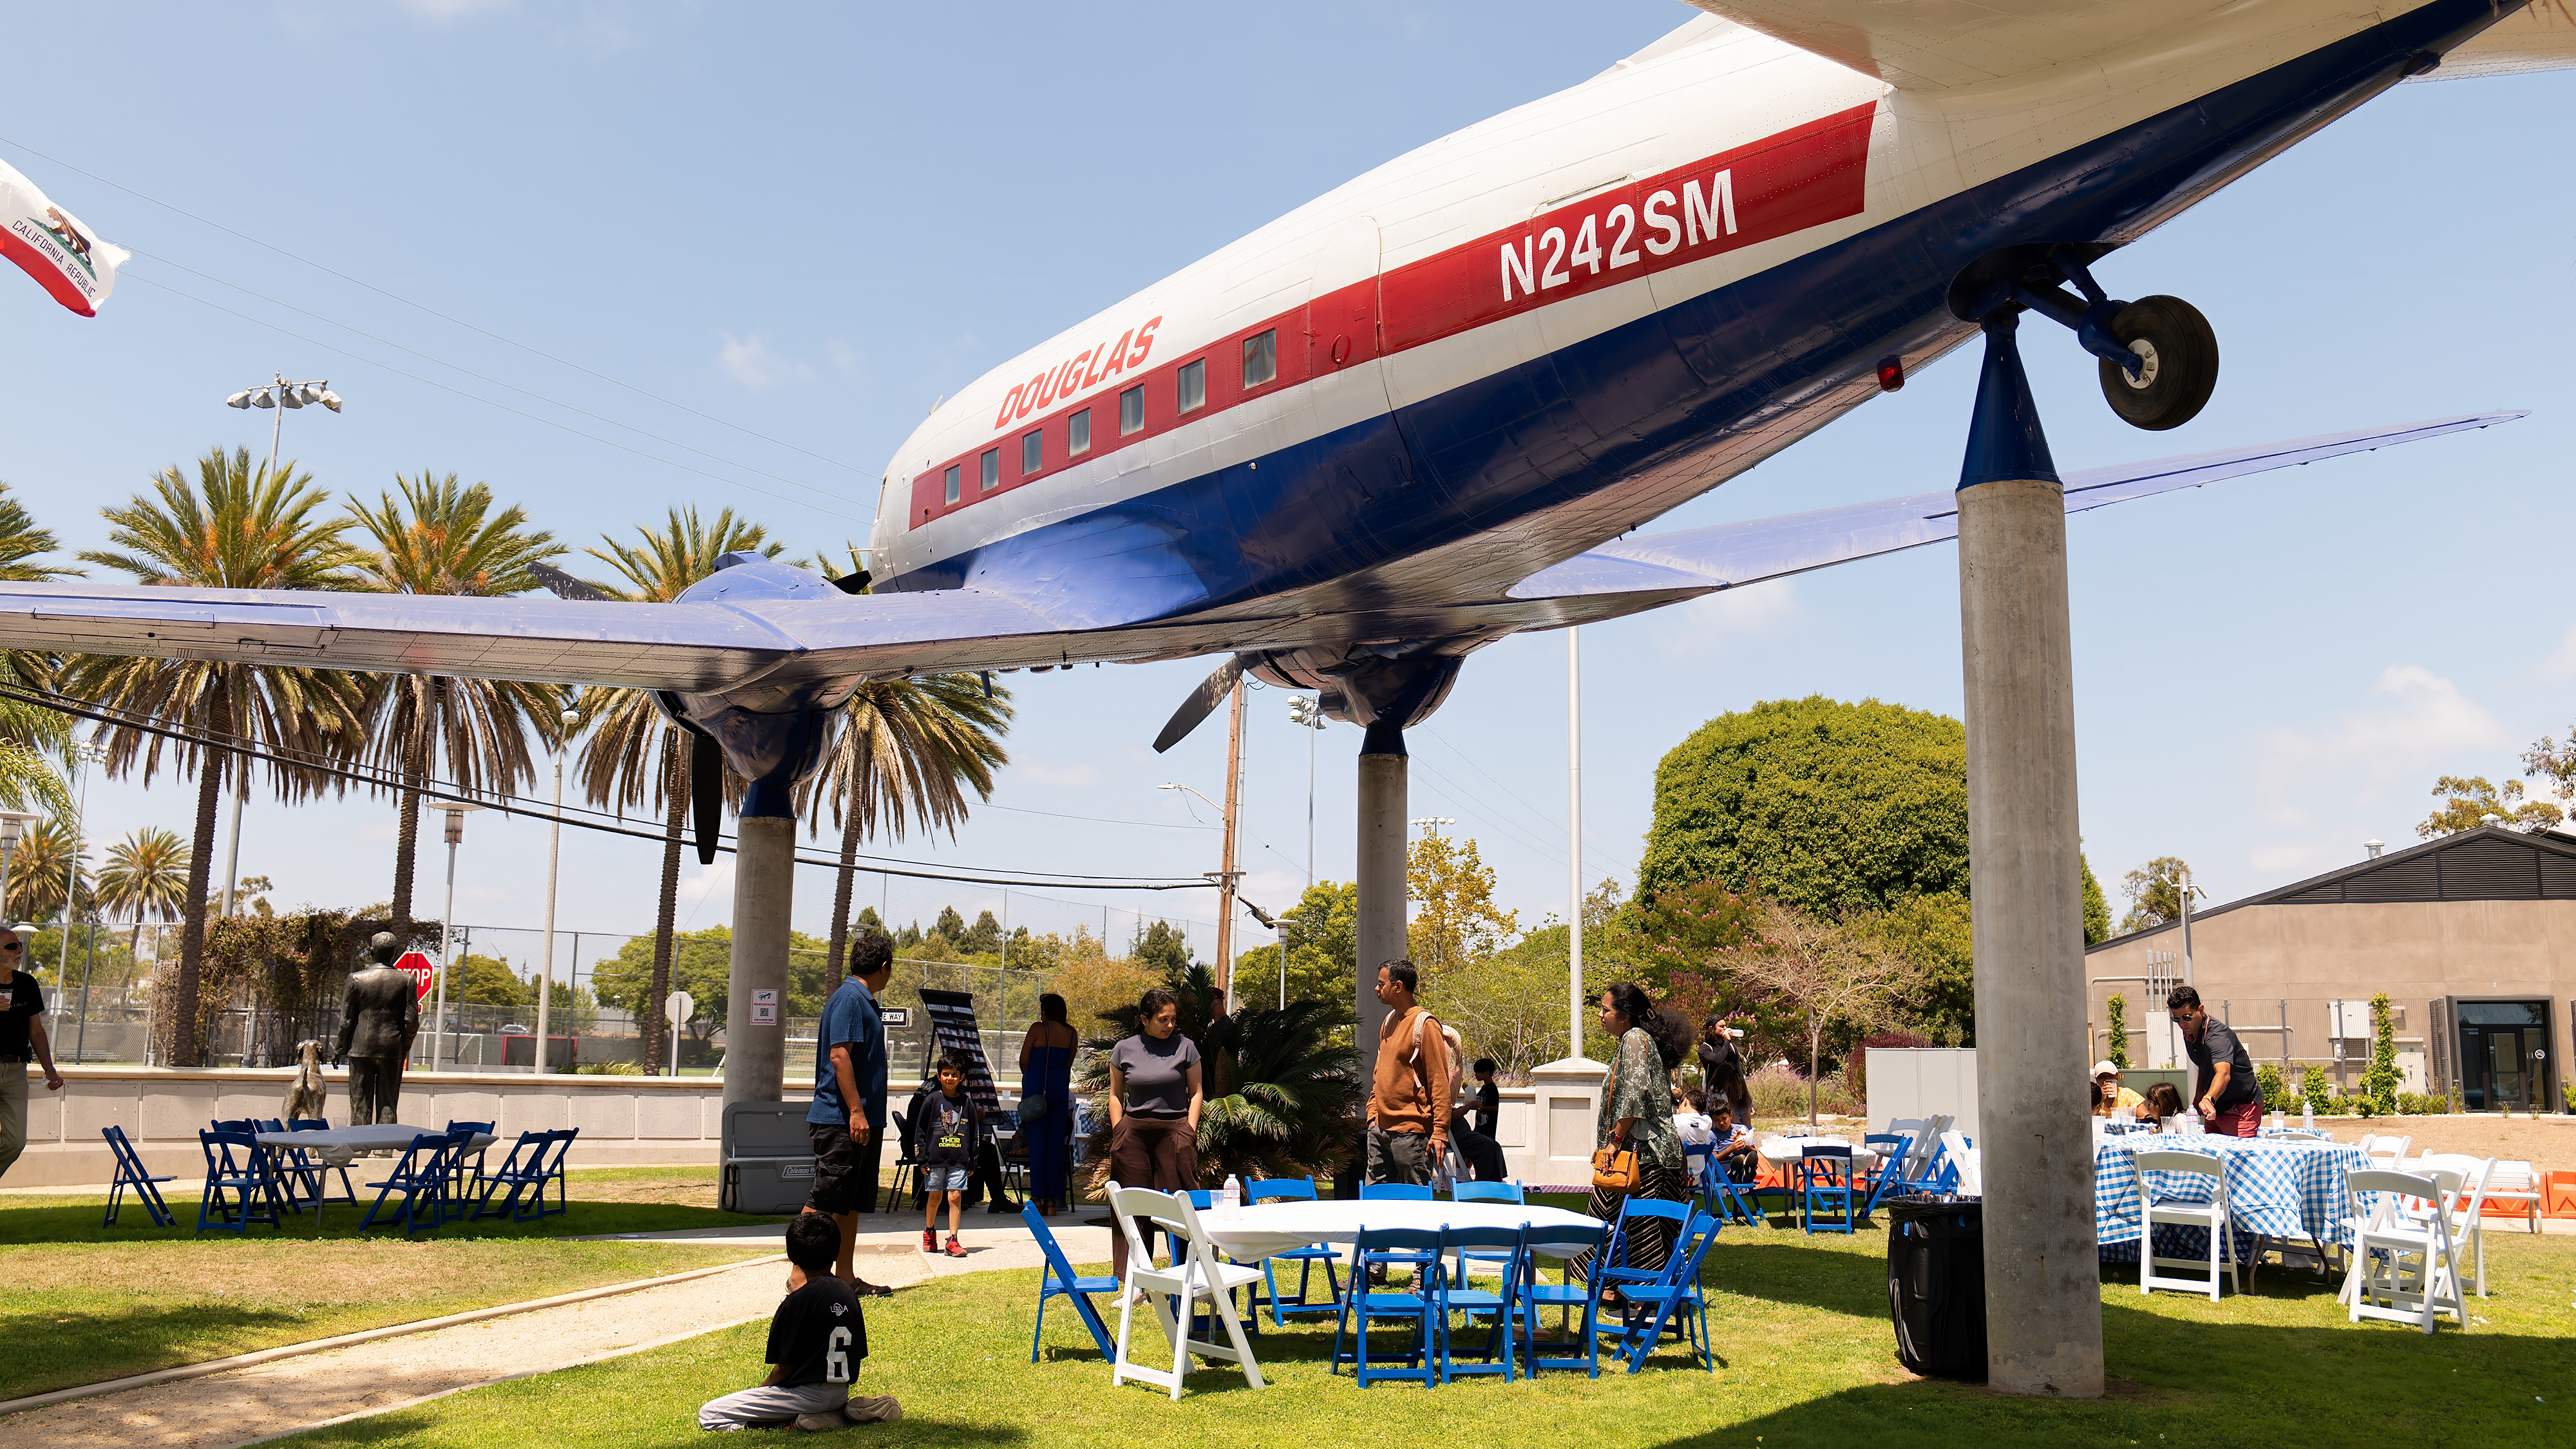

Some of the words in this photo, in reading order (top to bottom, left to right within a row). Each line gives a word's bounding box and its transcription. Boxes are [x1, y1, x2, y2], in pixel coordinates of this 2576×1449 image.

[12, 220, 64, 265] CALIFORNIA
[66, 263, 96, 298] REPUBLIC
[1501, 168, 1738, 302] N242SM
[994, 315, 1162, 430] DOUGLAS
[397, 968, 431, 987] OP
[826, 1326, 852, 1383] 6
